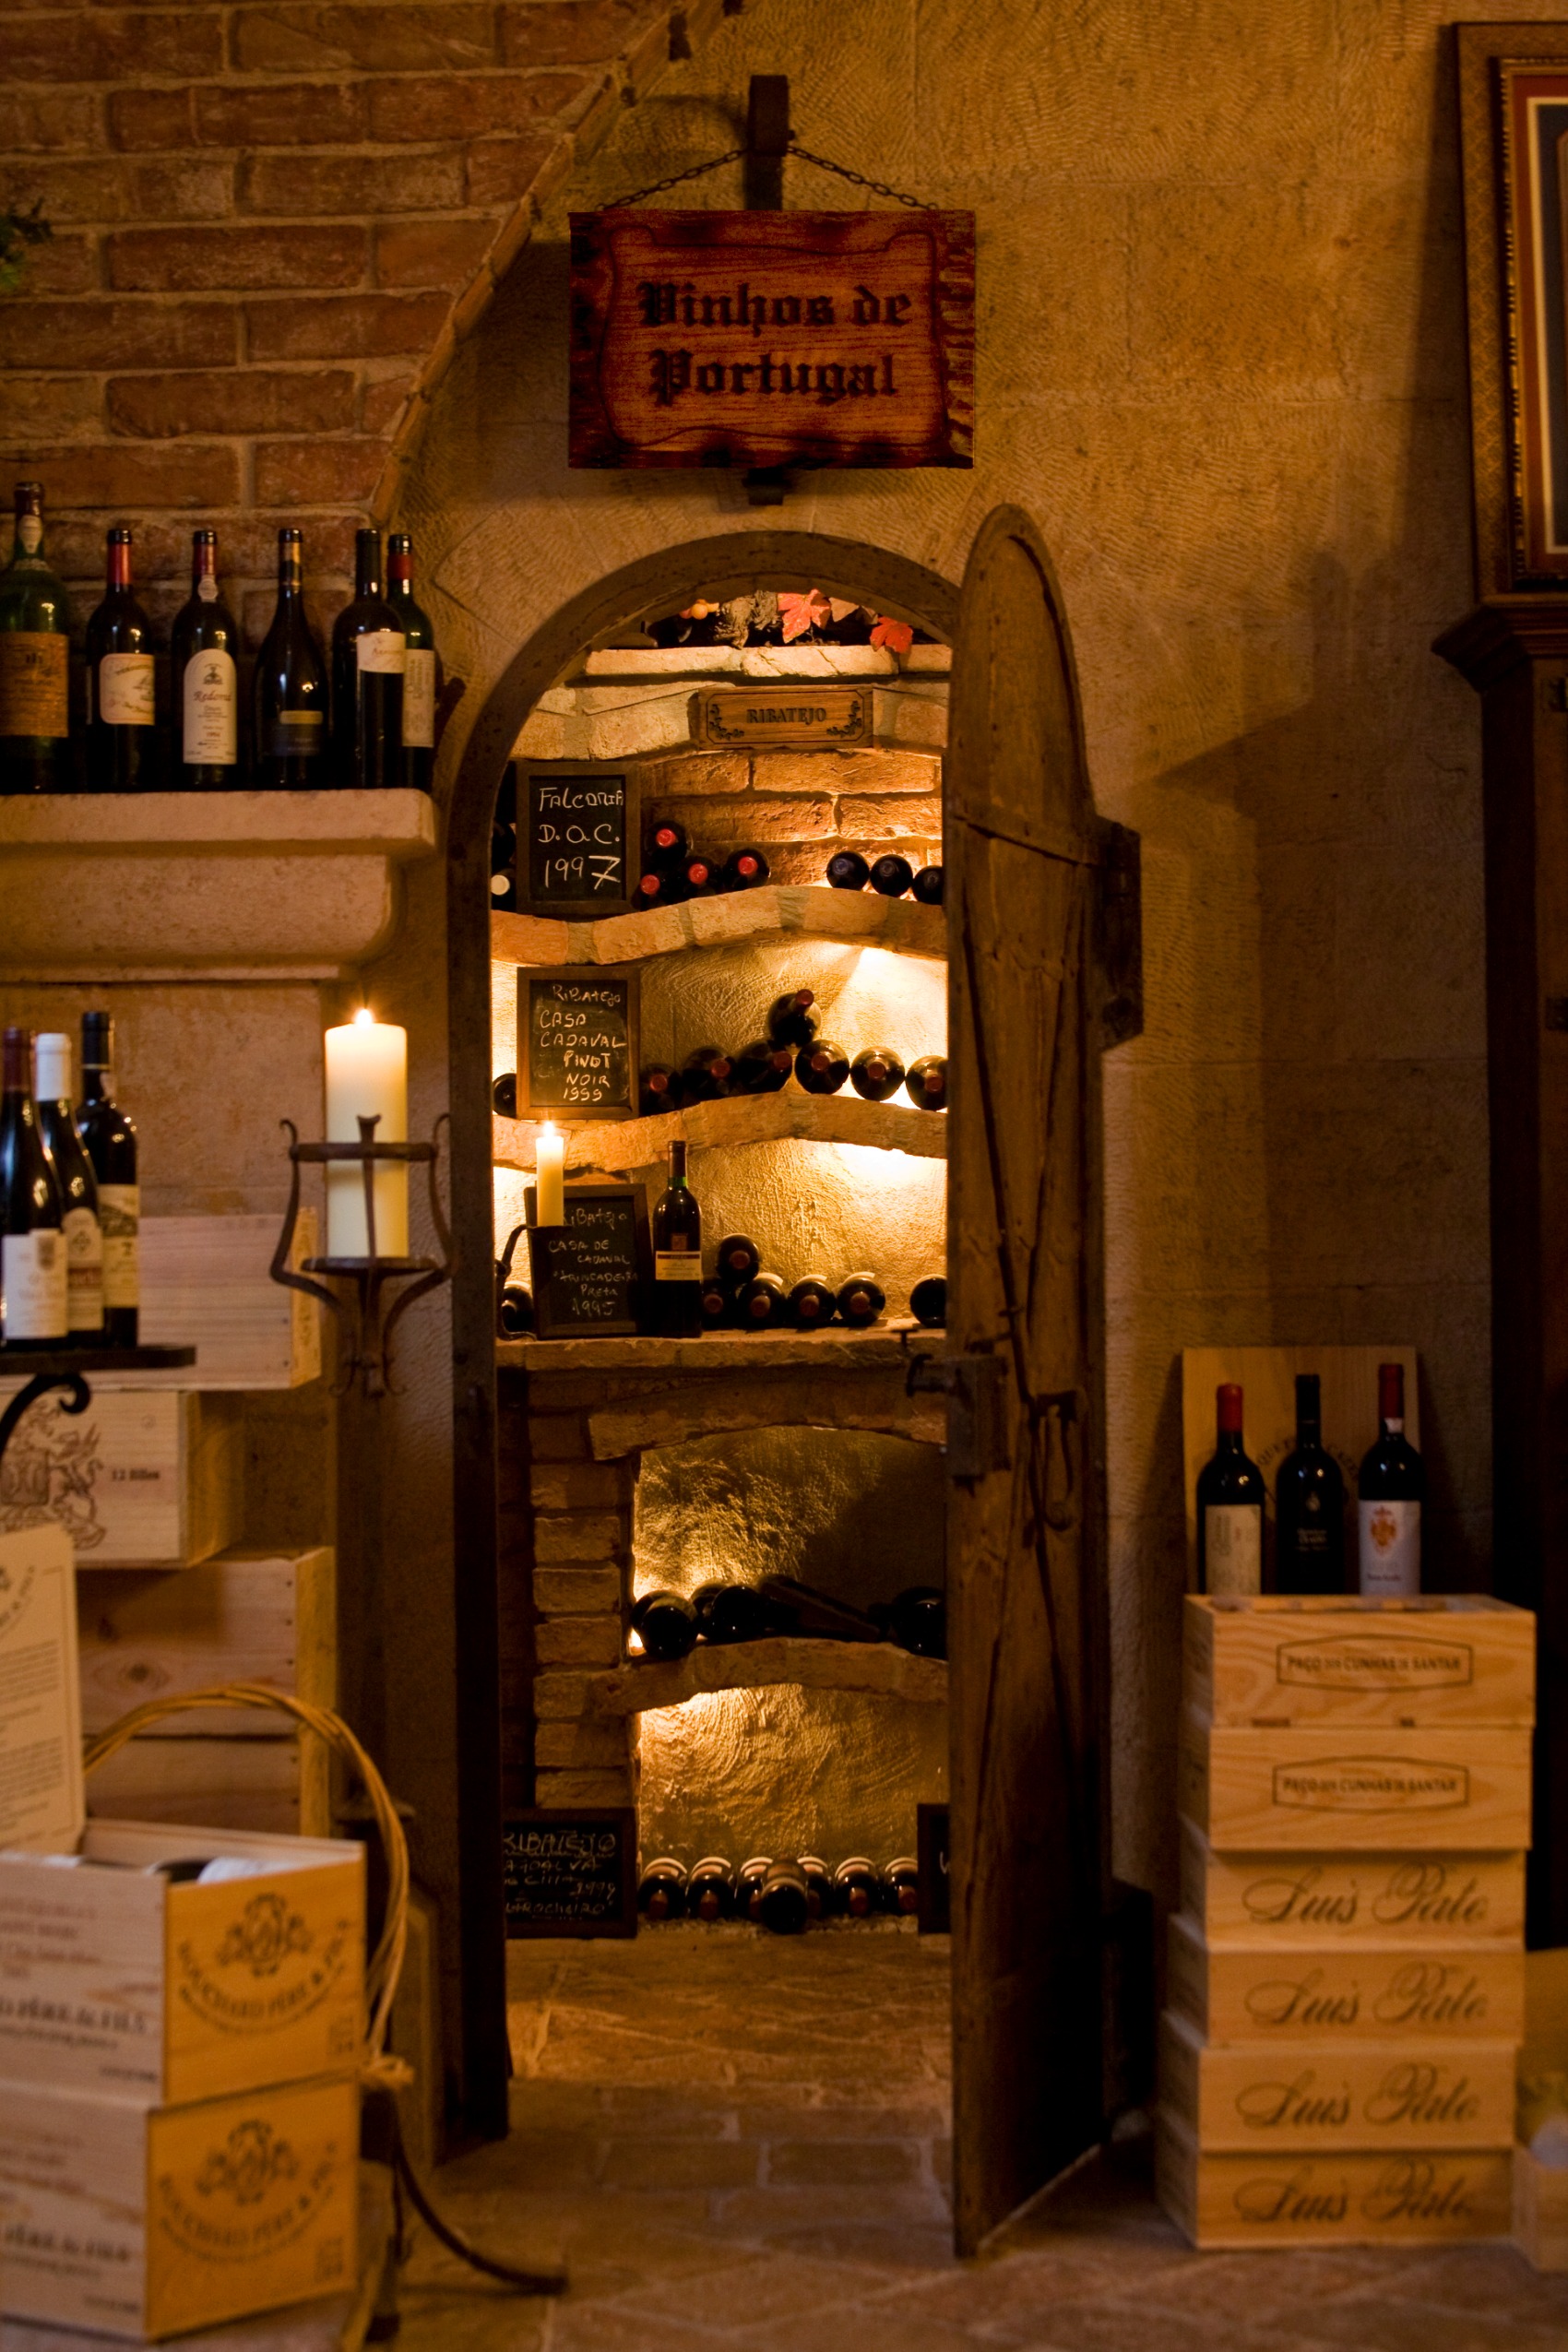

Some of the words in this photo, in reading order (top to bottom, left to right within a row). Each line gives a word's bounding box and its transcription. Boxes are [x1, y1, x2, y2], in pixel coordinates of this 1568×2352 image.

[636, 282, 836, 337] Vinhos
[850, 284, 912, 327] de
[647, 348, 898, 407] Portugal
[746, 707, 827, 725] RIBATEJO
[544, 855, 622, 891] 1997
[540, 1009, 587, 1028] CASA
[540, 1031, 628, 1049] CADAVAL
[564, 1050, 612, 1069] PINOT
[565, 1073, 611, 1088] NOIR
[563, 1087, 602, 1102] 1999
[548, 1240, 588, 1253] CASA
[594, 1240, 610, 1251] DE
[572, 1297, 616, 1318] 1995
